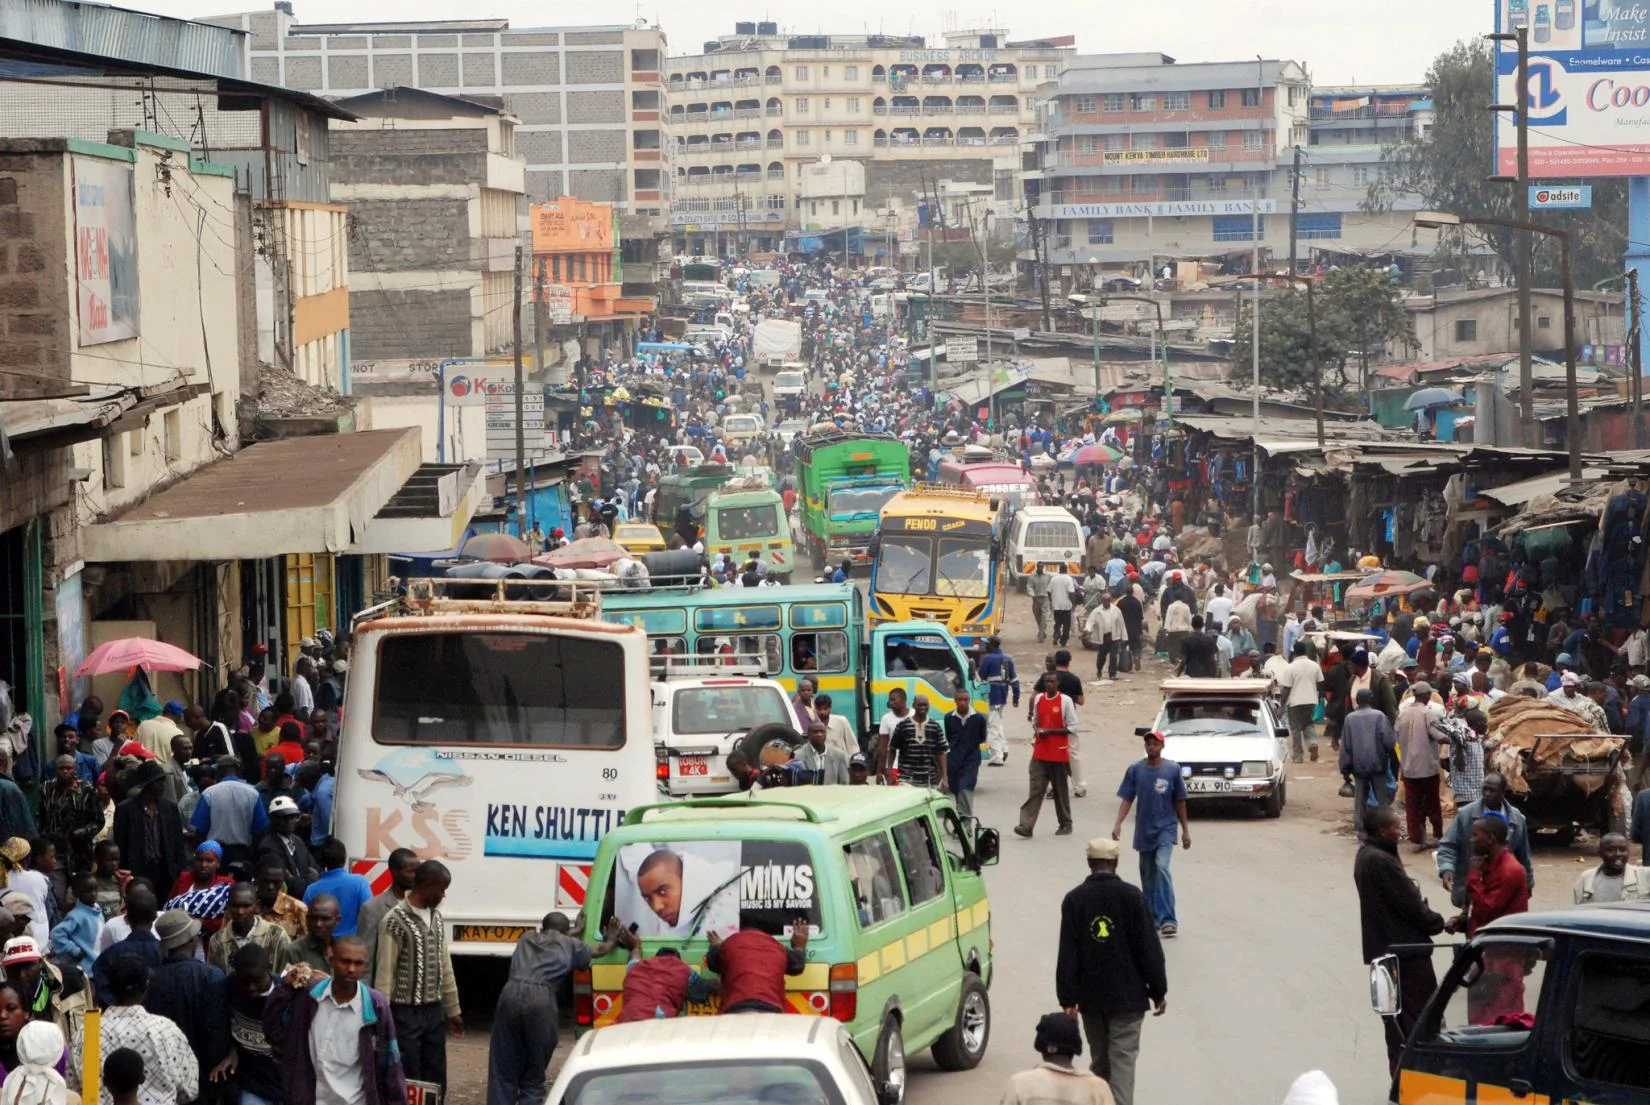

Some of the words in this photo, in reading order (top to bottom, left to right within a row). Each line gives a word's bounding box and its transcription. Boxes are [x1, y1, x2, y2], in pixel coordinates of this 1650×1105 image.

[1600, 3, 1647, 23] Make
[1604, 26, 1647, 41] Insist
[900, 50, 949, 61] BUSINESS
[959, 49, 998, 61] ARCADE
[1569, 56, 1622, 66] Enamelware
[1586, 78, 1650, 112] Coo
[1104, 152, 1123, 160] MOUNT
[1125, 151, 1143, 160] KENYA
[1550, 190, 1580, 201] adsite
[1063, 205, 1109, 216] FAMILY
[1115, 204, 1152, 215] BANK
[1168, 203, 1216, 214] FAMILY
[409, 363, 439, 373] STOR
[904, 518, 937, 530] PENDO
[436, 751, 499, 760] NISSAN
[501, 753, 567, 763] DIESEL
[602, 767, 618, 780] 80
[1214, 781, 1231, 791] 910
[486, 803, 527, 838] KEN
[364, 806, 472, 861] KSS
[740, 859, 813, 900] MIMS
[740, 900, 763, 909] MUSIC
[764, 900, 772, 909] IS
[773, 900, 784, 909] MY
[785, 899, 812, 909] SAVIOR
[462, 926, 489, 939] KAY
